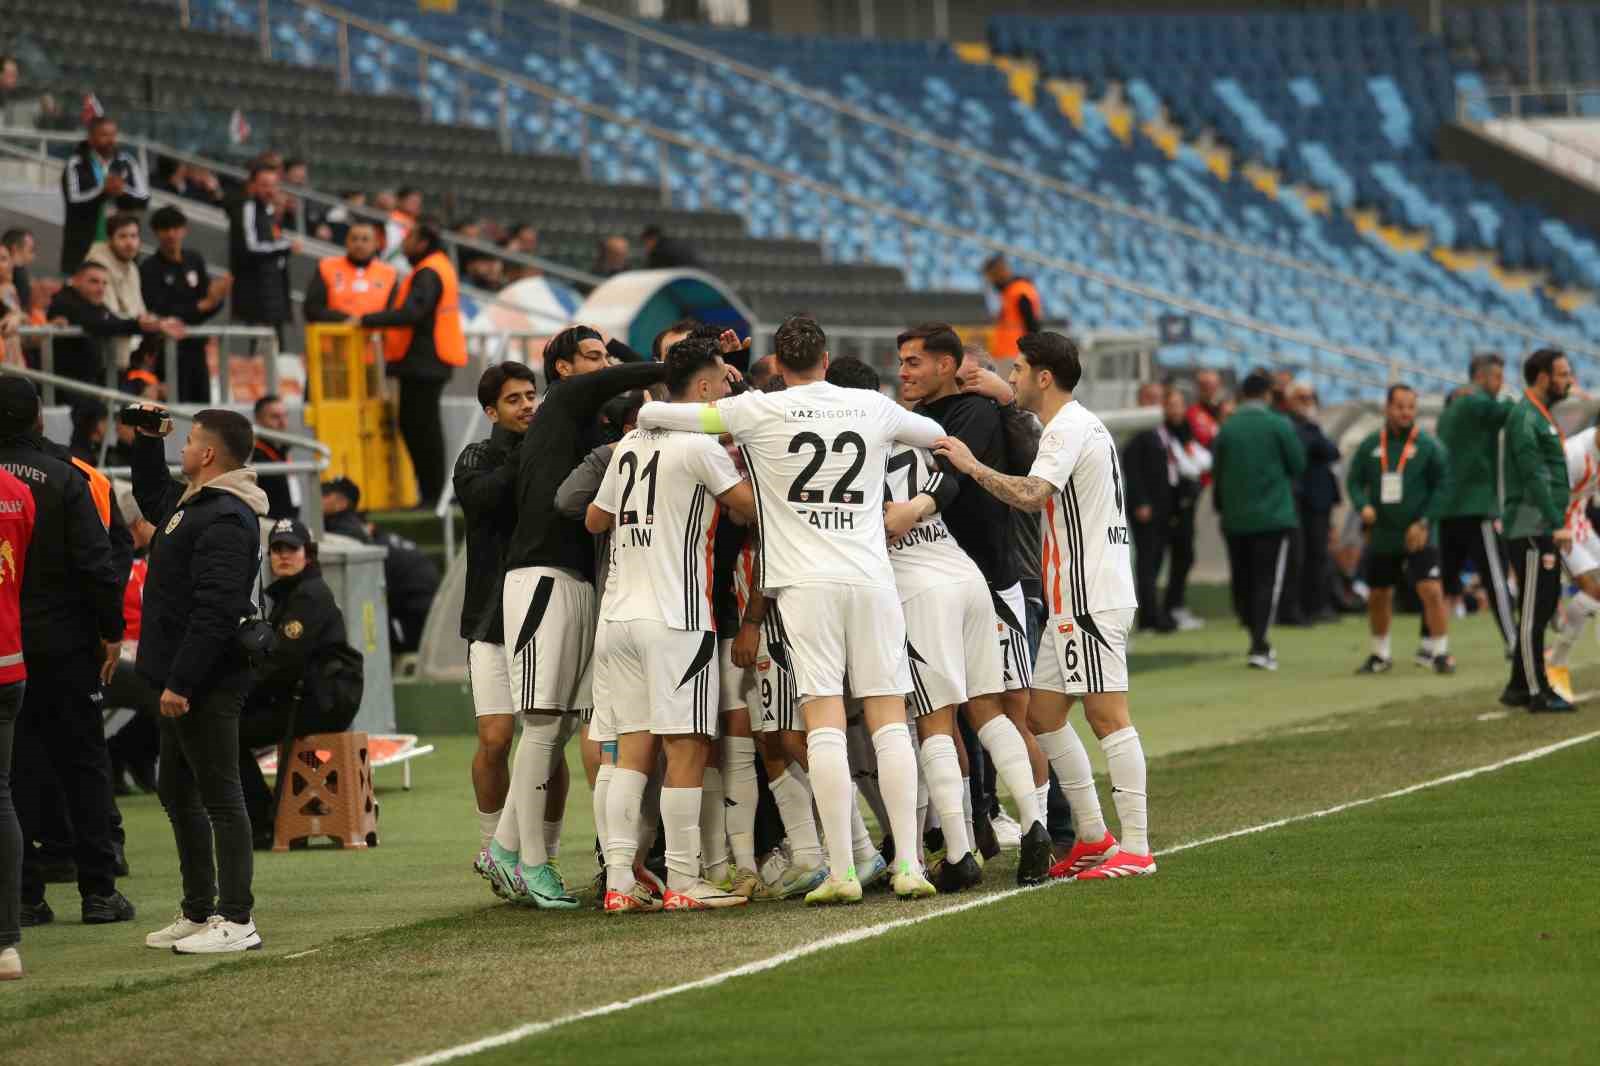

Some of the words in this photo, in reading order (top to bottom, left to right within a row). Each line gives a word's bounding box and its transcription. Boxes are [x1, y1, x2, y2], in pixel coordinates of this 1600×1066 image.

[787, 430, 867, 504] 22
[618, 450, 661, 527] 21
[796, 506, 854, 530] ATİH
[1065, 638, 1079, 670] 6
[761, 678, 773, 709] 9
